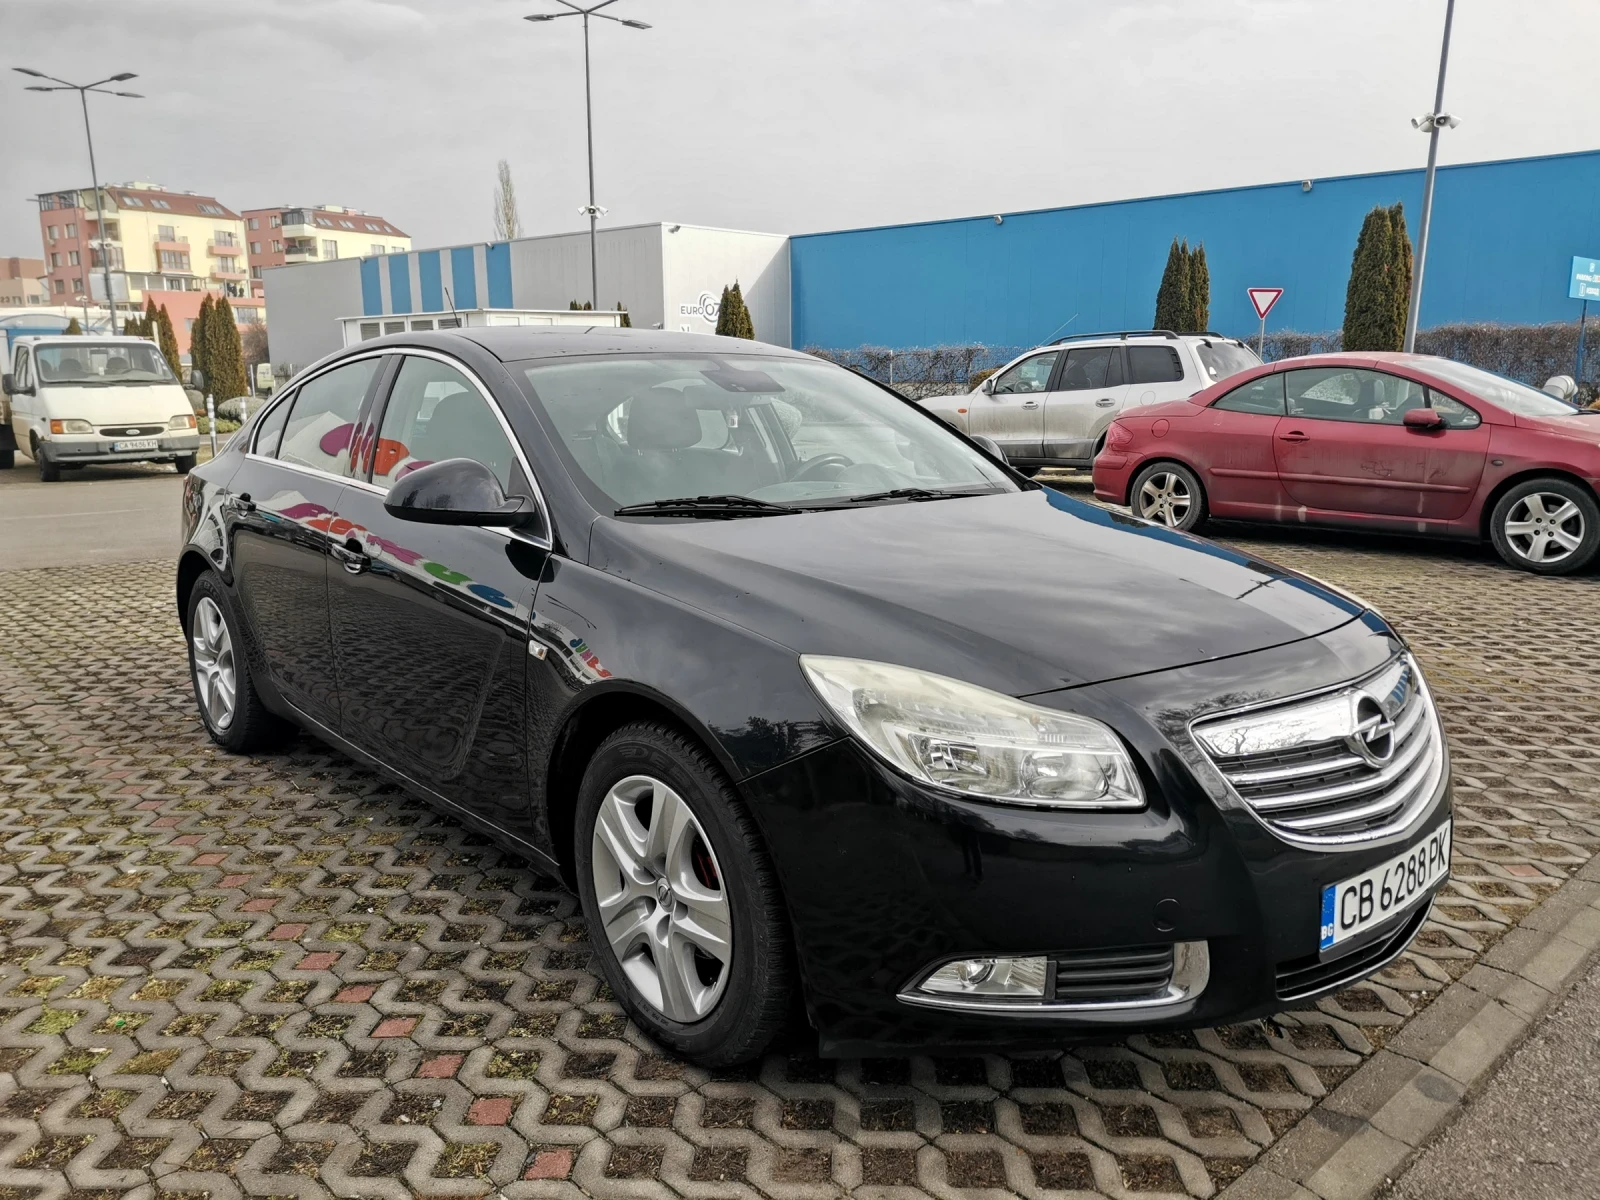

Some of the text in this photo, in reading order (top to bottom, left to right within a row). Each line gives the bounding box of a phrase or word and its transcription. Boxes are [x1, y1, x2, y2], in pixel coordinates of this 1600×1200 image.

[680, 305, 704, 315] EURO
[1341, 828, 1448, 931] CB 6288 PK
[1321, 924, 1333, 940] BG
